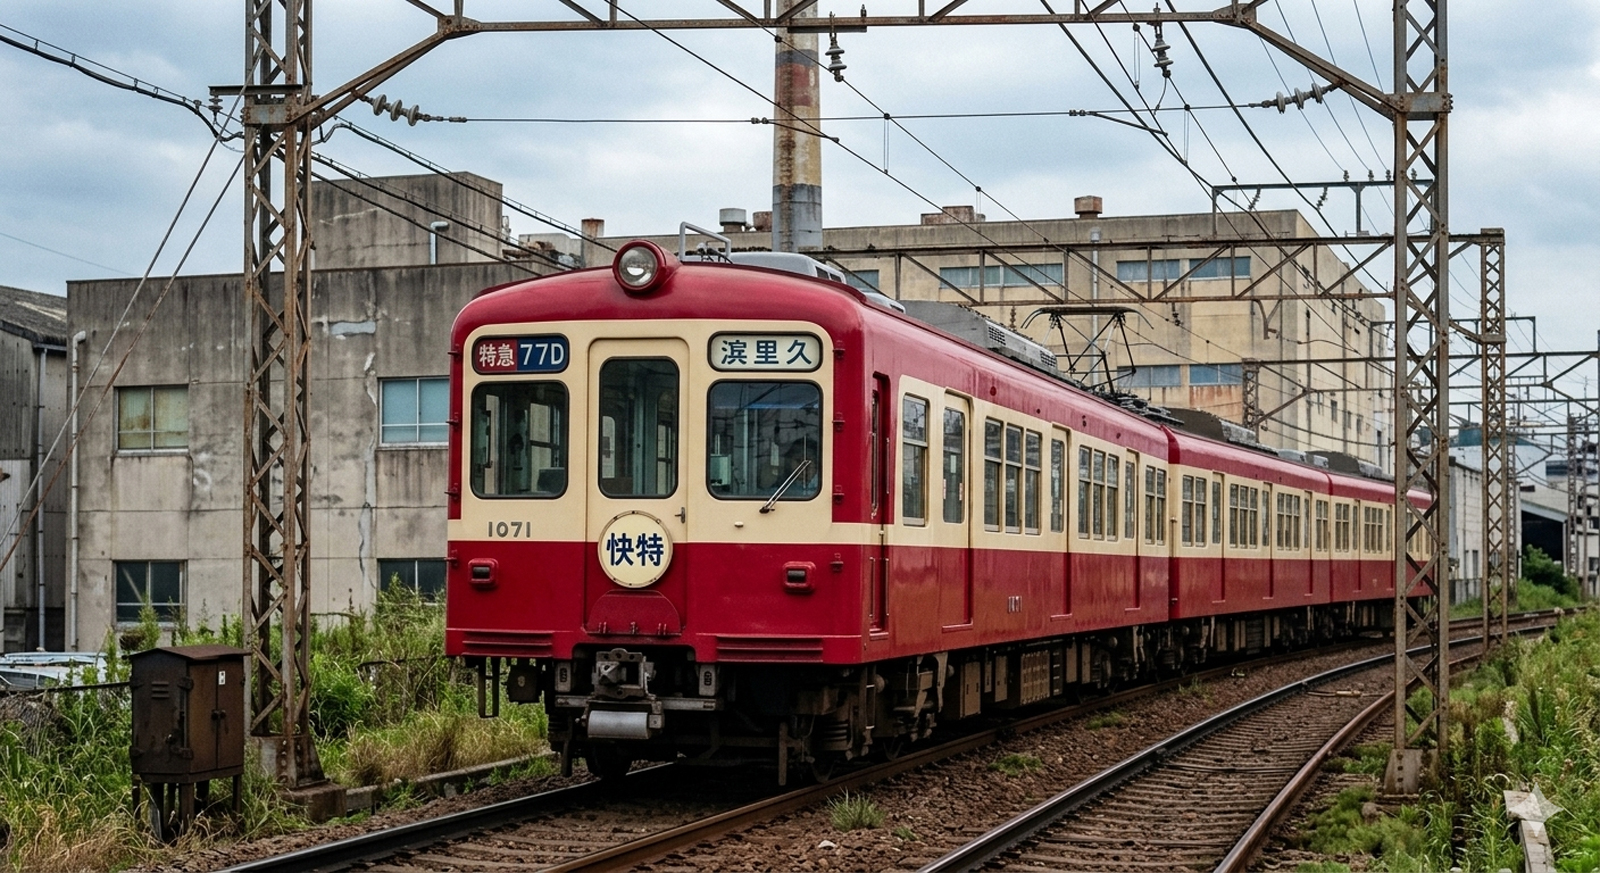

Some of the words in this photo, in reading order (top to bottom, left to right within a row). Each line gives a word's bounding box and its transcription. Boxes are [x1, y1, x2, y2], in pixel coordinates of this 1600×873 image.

[479, 343, 515, 367] 特急
[520, 343, 565, 366] 77D
[488, 521, 531, 538] 1071
[606, 532, 664, 567] 快特
